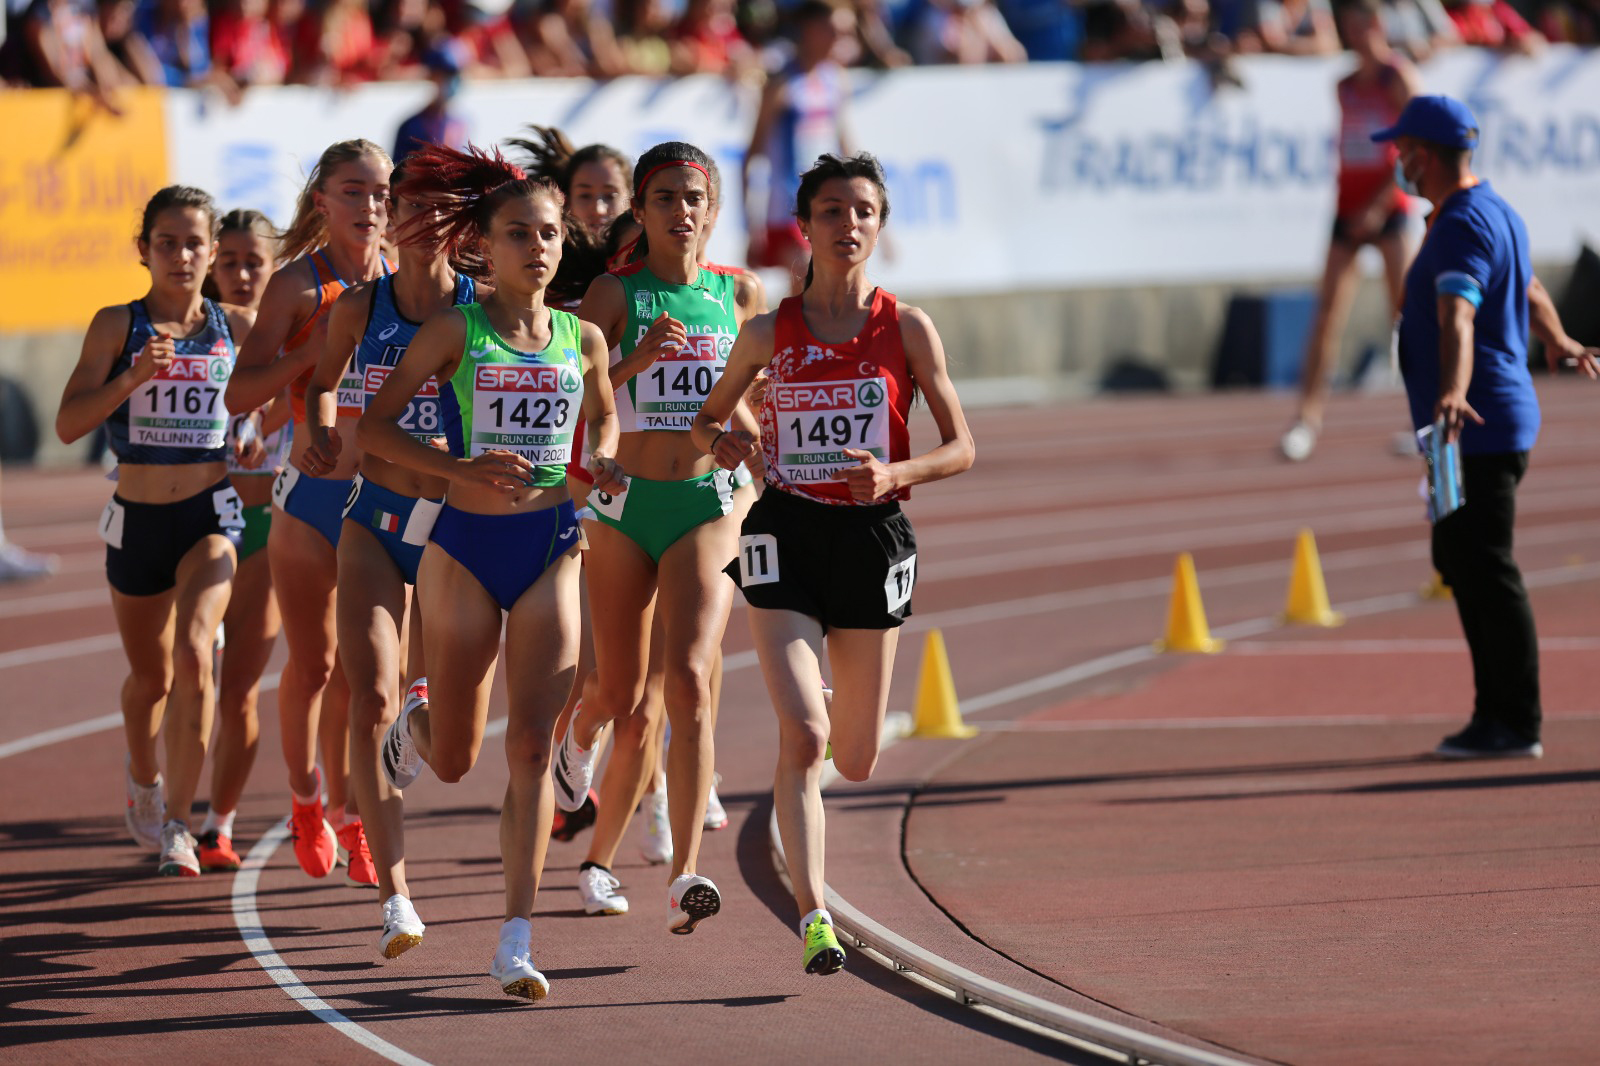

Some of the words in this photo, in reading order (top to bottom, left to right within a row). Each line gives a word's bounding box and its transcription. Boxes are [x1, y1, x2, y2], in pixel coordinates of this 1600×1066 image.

[478, 369, 556, 389] SPAR
[145, 385, 220, 415] 1167
[777, 387, 853, 409] SPAR
[489, 397, 570, 428] 1423
[665, 403, 684, 411] RUN
[178, 420, 211, 429] CLEAN
[646, 416, 694, 427] TALLIN
[138, 430, 194, 443] TALLINN
[495, 434, 499, 443] I
[501, 434, 524, 444] RUN
[526, 435, 557, 444] CLEAN
[790, 413, 874, 448] 1497
[543, 448, 566, 462] 2021
[803, 454, 825, 463] RUN
[745, 544, 769, 577] 11
[893, 566, 912, 600] 11
